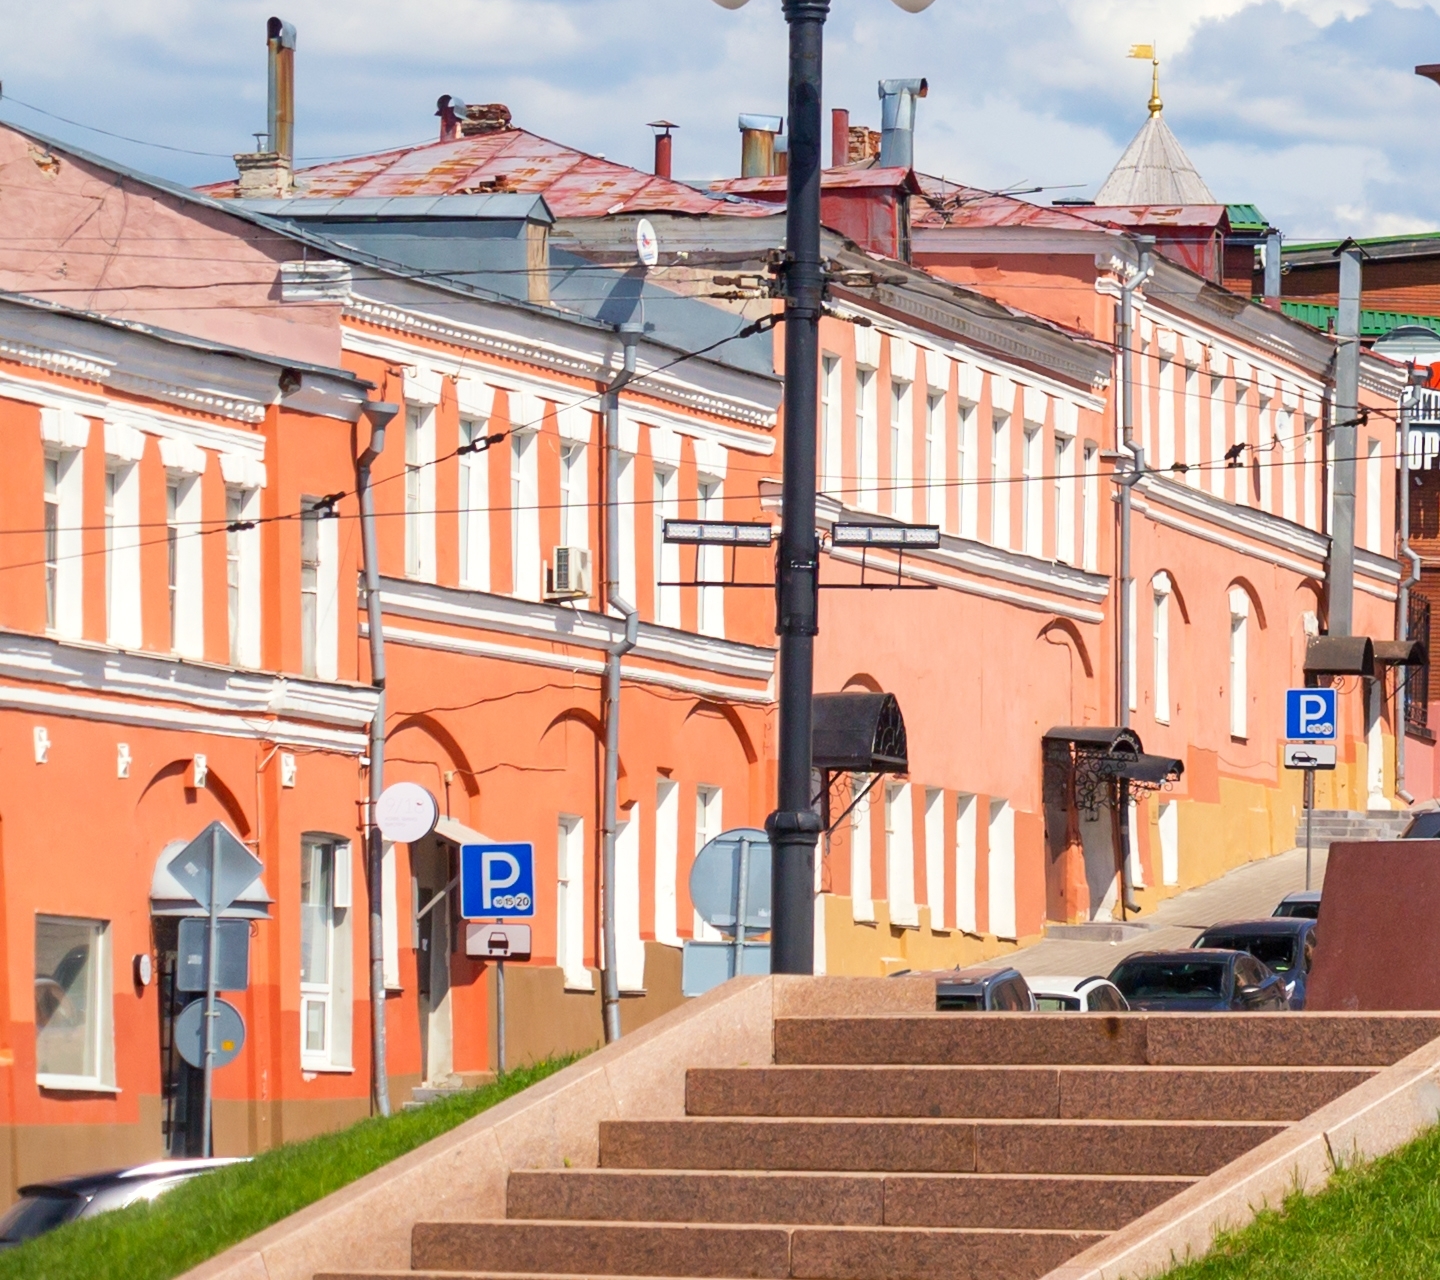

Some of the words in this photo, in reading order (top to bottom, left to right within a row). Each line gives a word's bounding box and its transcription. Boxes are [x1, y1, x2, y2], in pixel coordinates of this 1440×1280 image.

[1299, 694, 1327, 734] P
[481, 851, 520, 909] P
[516, 896, 530, 907] 20
